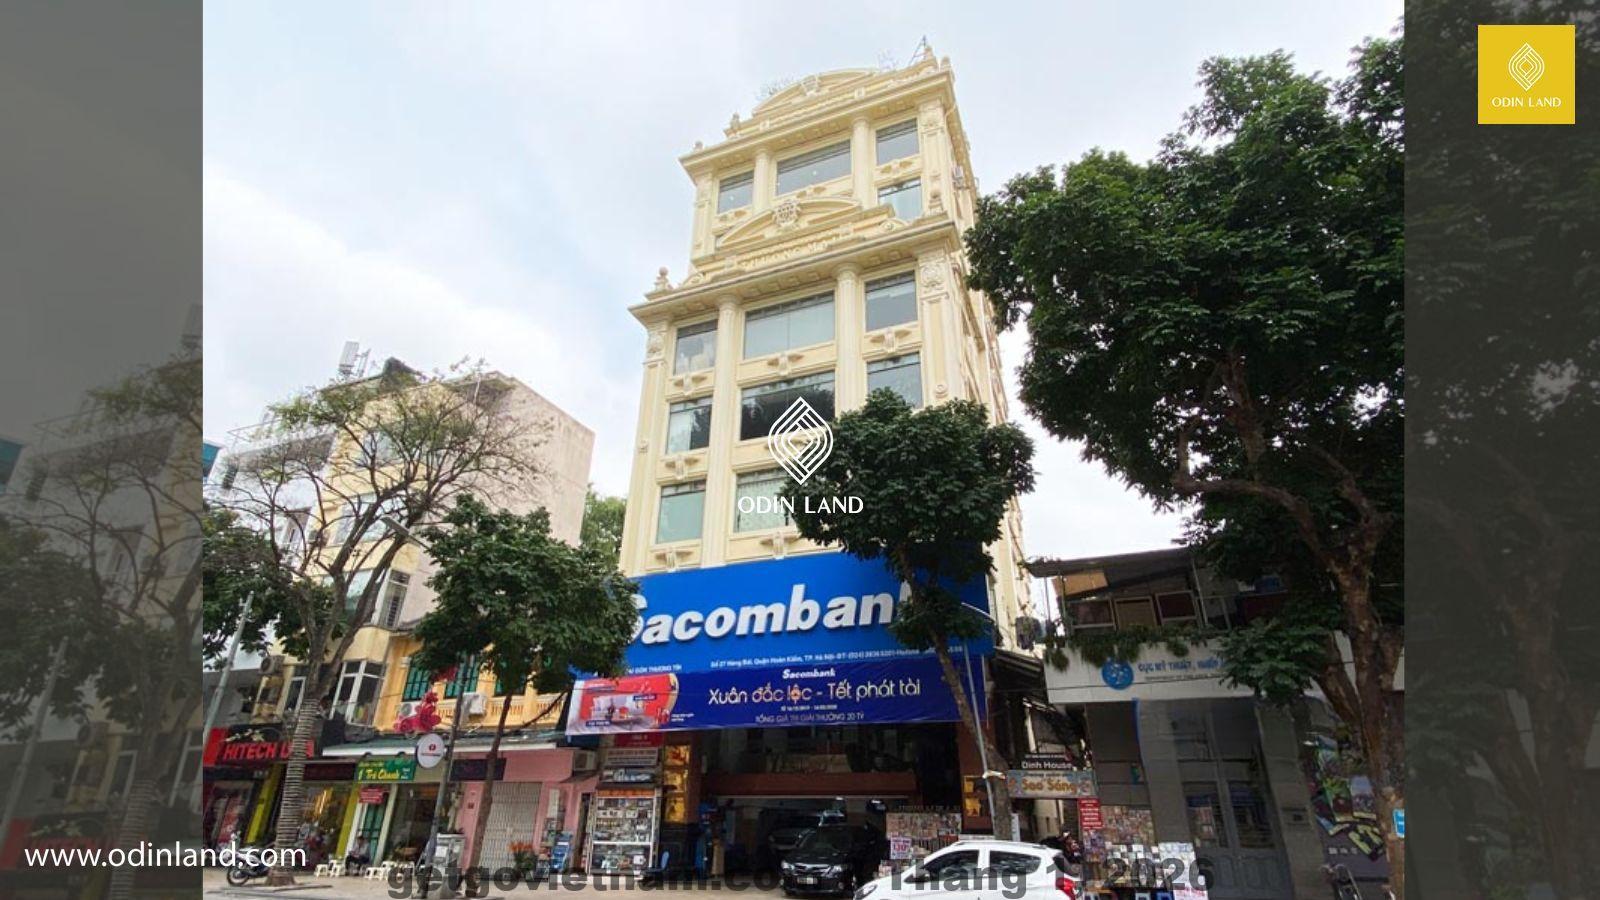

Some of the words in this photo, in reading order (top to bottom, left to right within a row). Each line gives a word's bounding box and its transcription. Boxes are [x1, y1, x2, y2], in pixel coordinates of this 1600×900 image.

[628, 580, 912, 645] Sacomban
[782, 668, 836, 680] Sacombank
[708, 686, 748, 705] Xuân
[752, 682, 785, 703] đắc
[787, 683, 812, 705] lộc
[827, 679, 852, 700] Tết
[856, 678, 896, 702] phát
[900, 677, 921, 696] tài
[223, 741, 278, 760] HITECH
